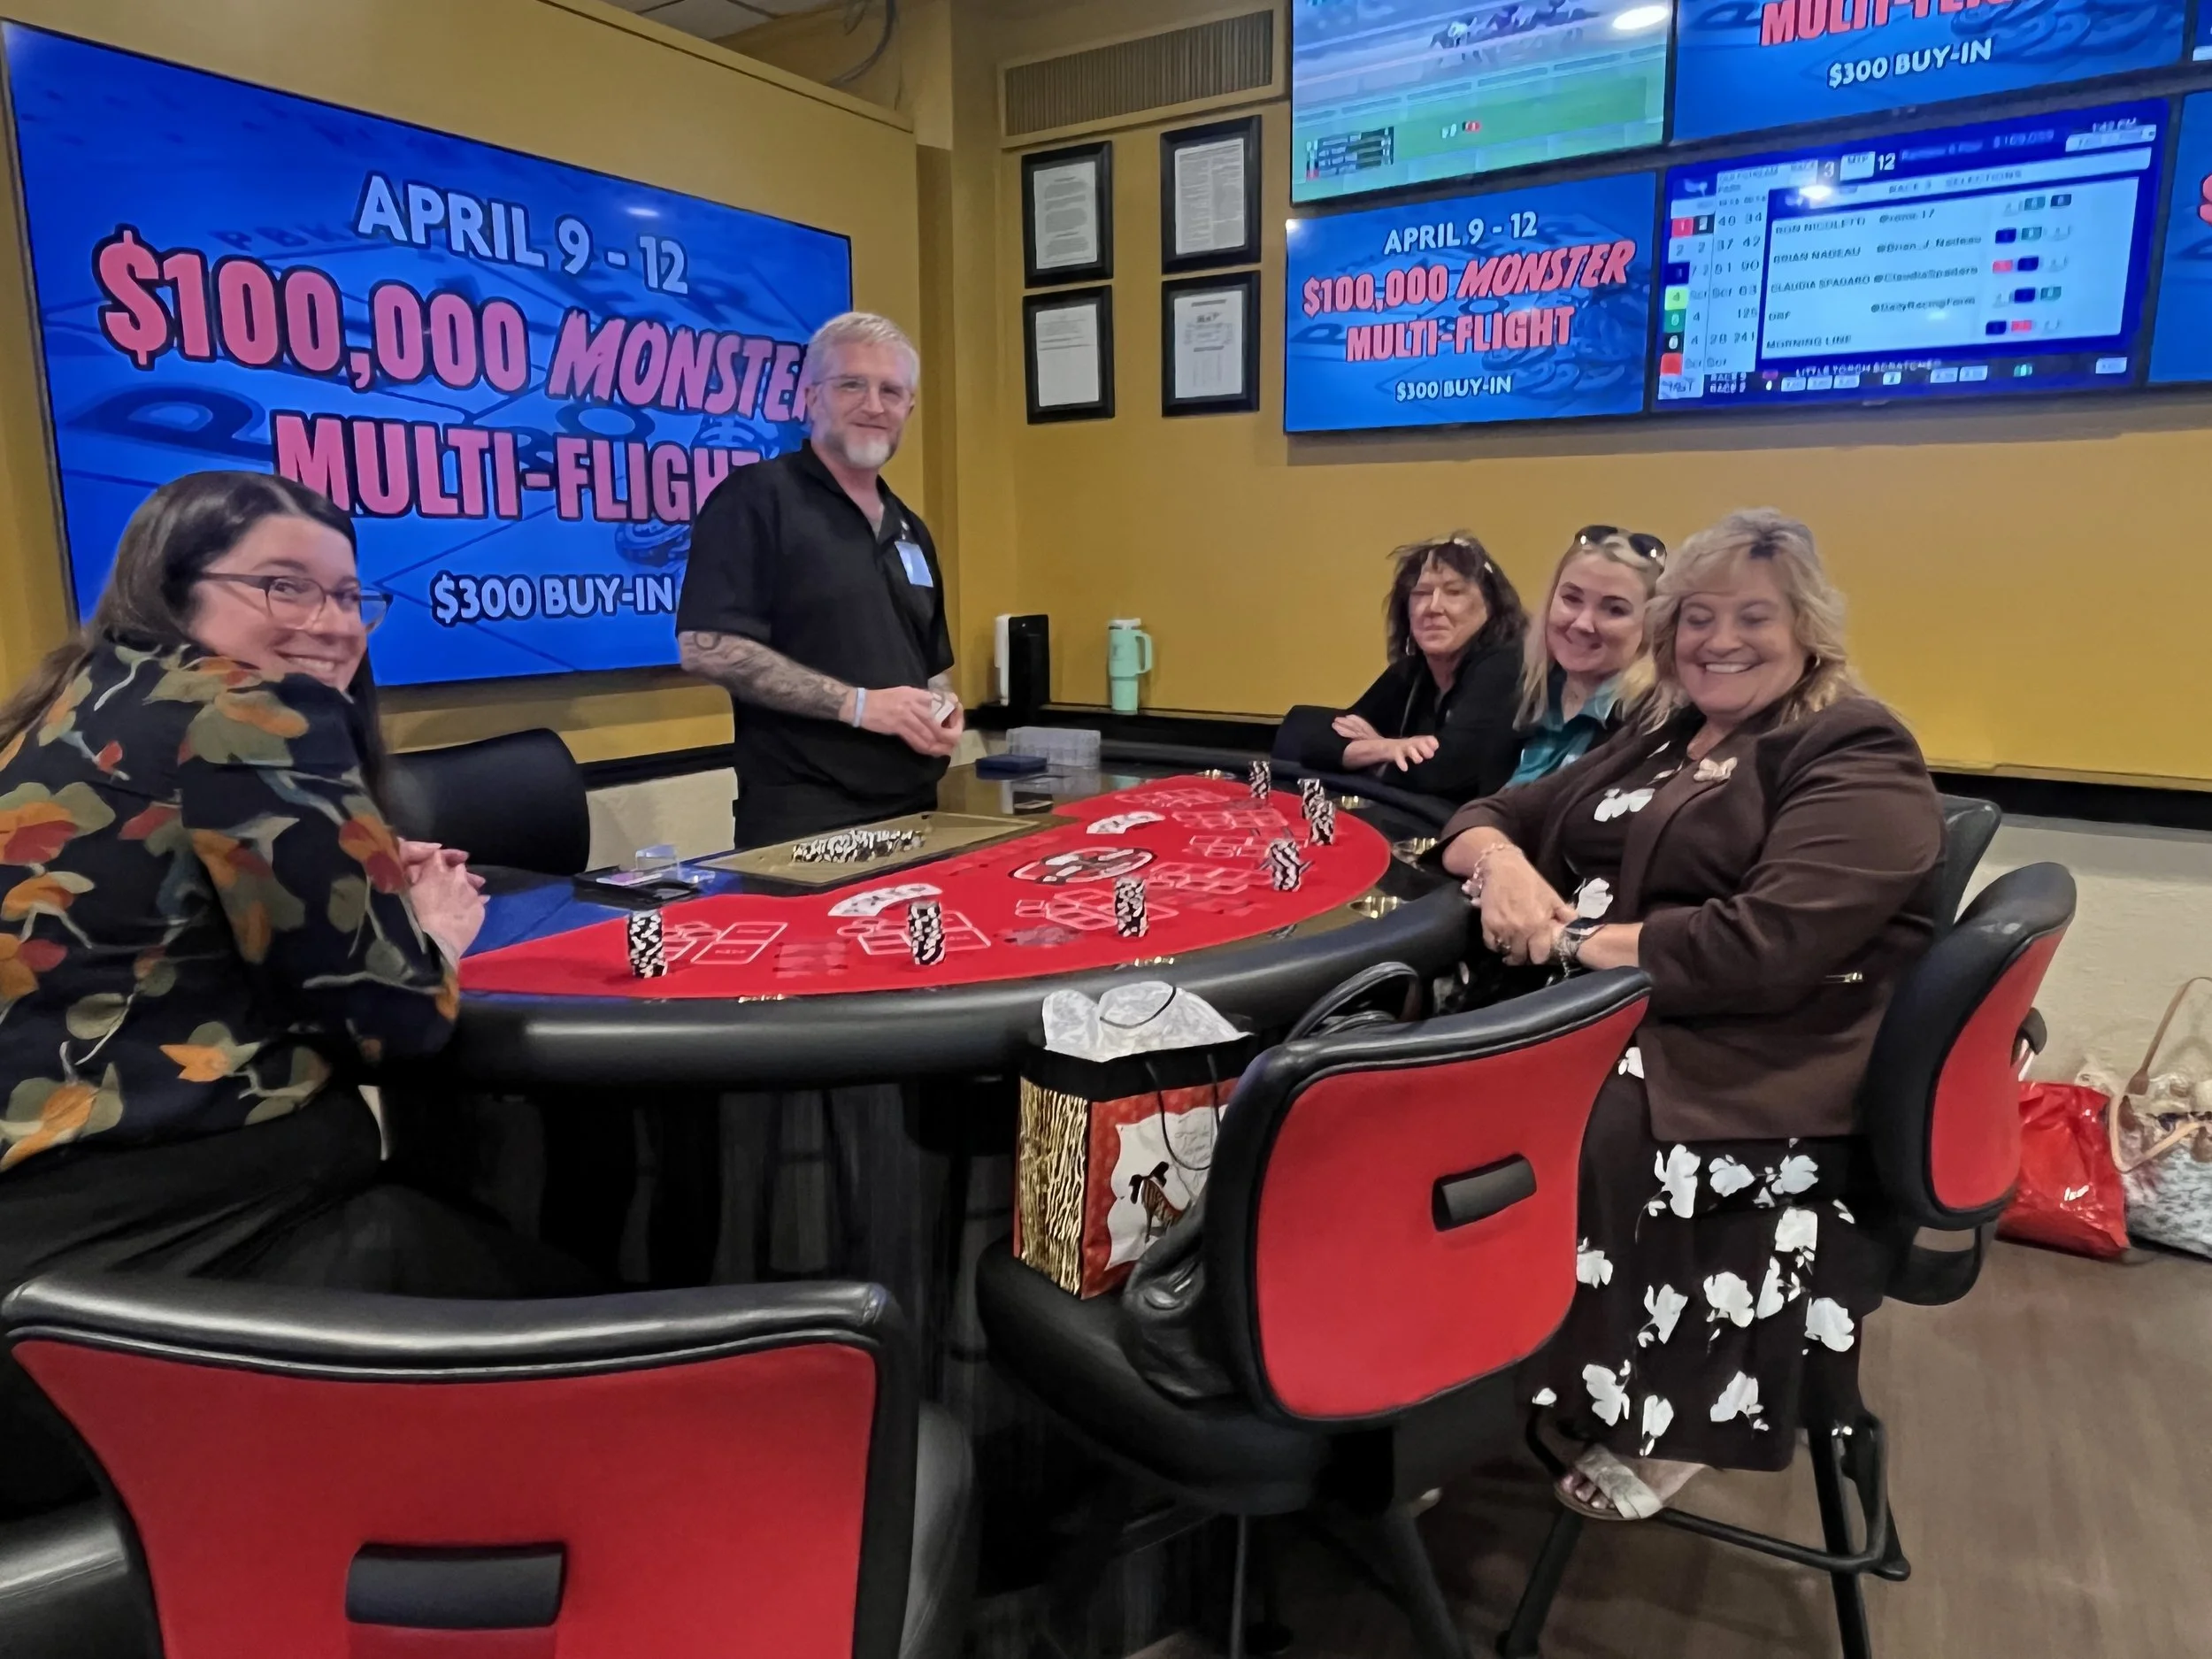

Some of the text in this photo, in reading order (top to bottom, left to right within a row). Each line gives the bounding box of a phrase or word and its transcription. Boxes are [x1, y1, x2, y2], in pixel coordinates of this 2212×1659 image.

[1829, 37, 1992, 88] $300 BUY-IN
[1878, 152, 1895, 171] 12
[357, 175, 688, 296] APRIL 9 - 12
[1383, 222, 1461, 256] APRIL
[1468, 218, 1485, 244] 9
[1509, 211, 1538, 238] 12
[1302, 239, 1637, 318] $100,000 MONSTER
[97, 228, 530, 393] $100,000
[1346, 306, 1576, 364] MULTI-FLIGHT
[1395, 374, 1513, 403] $300 BUY-IN
[274, 413, 763, 522] MULTI-FLIGH
[434, 572, 676, 624] $300 BUY-IN
